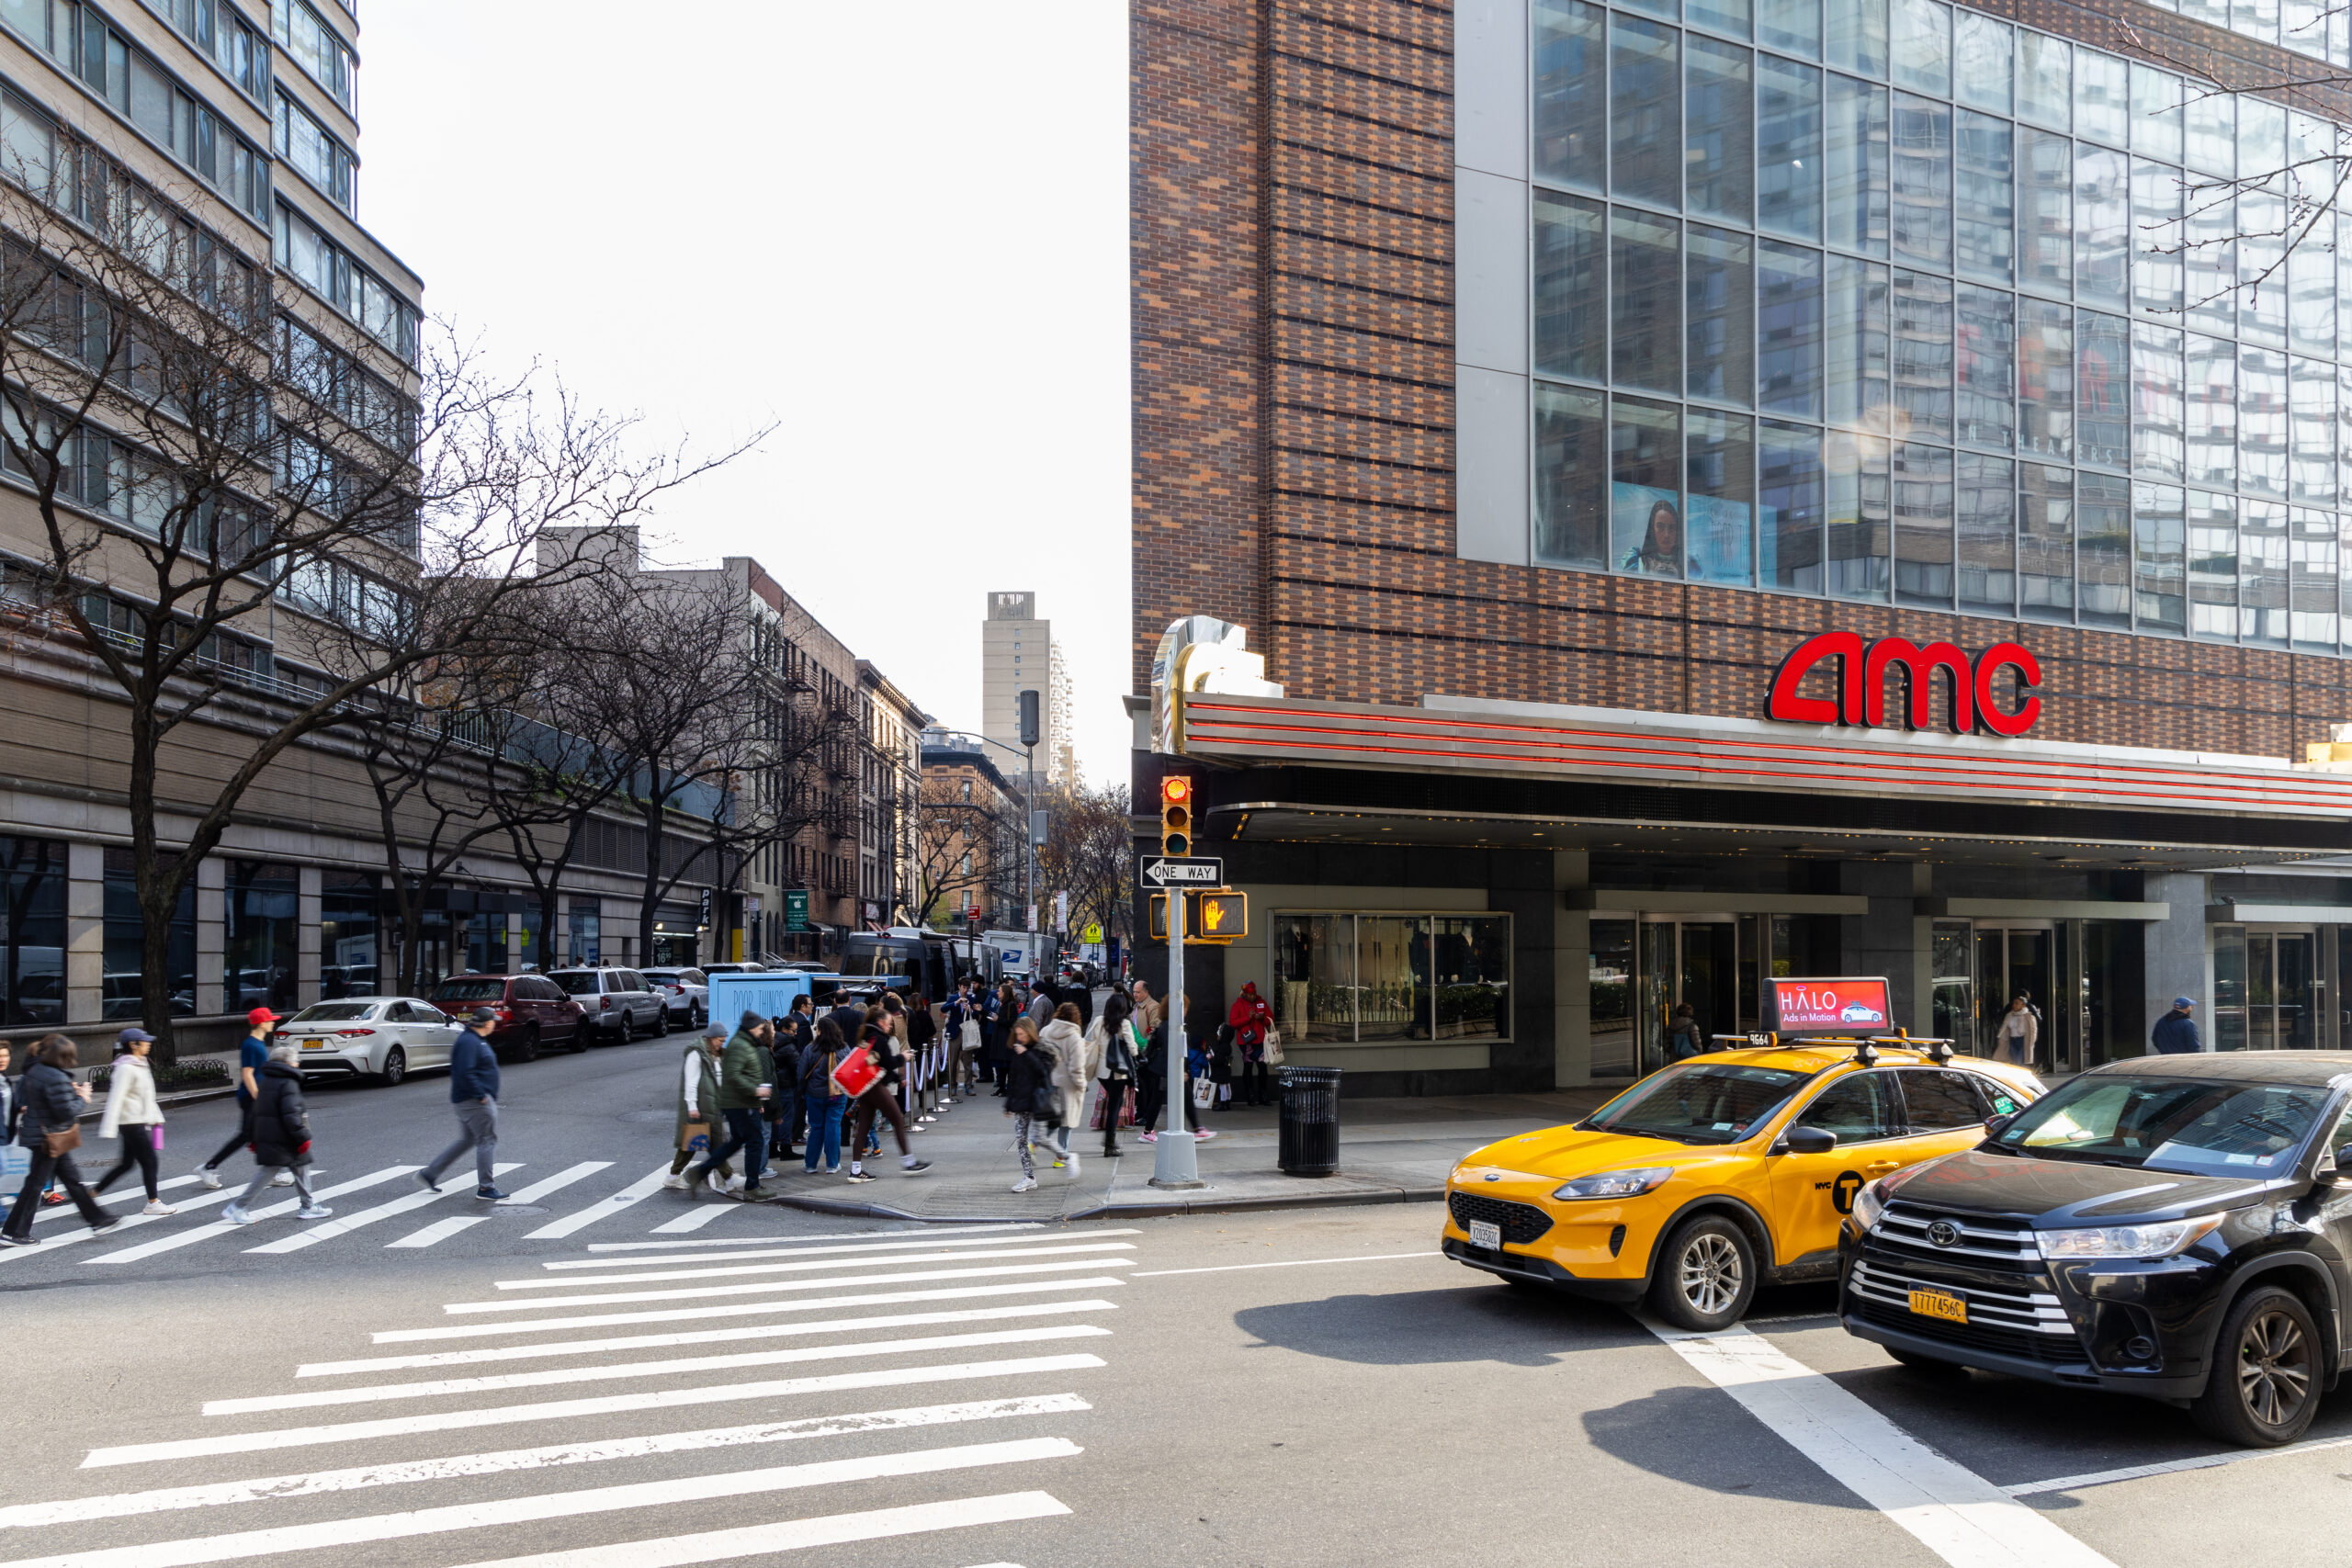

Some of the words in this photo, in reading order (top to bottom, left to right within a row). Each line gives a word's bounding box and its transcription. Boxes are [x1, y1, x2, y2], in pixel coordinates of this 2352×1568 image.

[2002, 430, 2112, 465] THEATERS
[2000, 530, 2067, 559] TROY
[1154, 866, 1177, 878] ONE
[1187, 867, 1212, 879] WAY
[733, 989, 754, 1021] POOR
[757, 989, 784, 1020] THINGS
[1782, 1013, 1799, 1022] Ads
[1800, 1013, 1808, 1021] in
[1809, 1012, 1837, 1021] Motion
[1749, 1034, 1769, 1045] 9G64
[1815, 1181, 1832, 1190] NYC
[1915, 1292, 1961, 1316] T777456C
